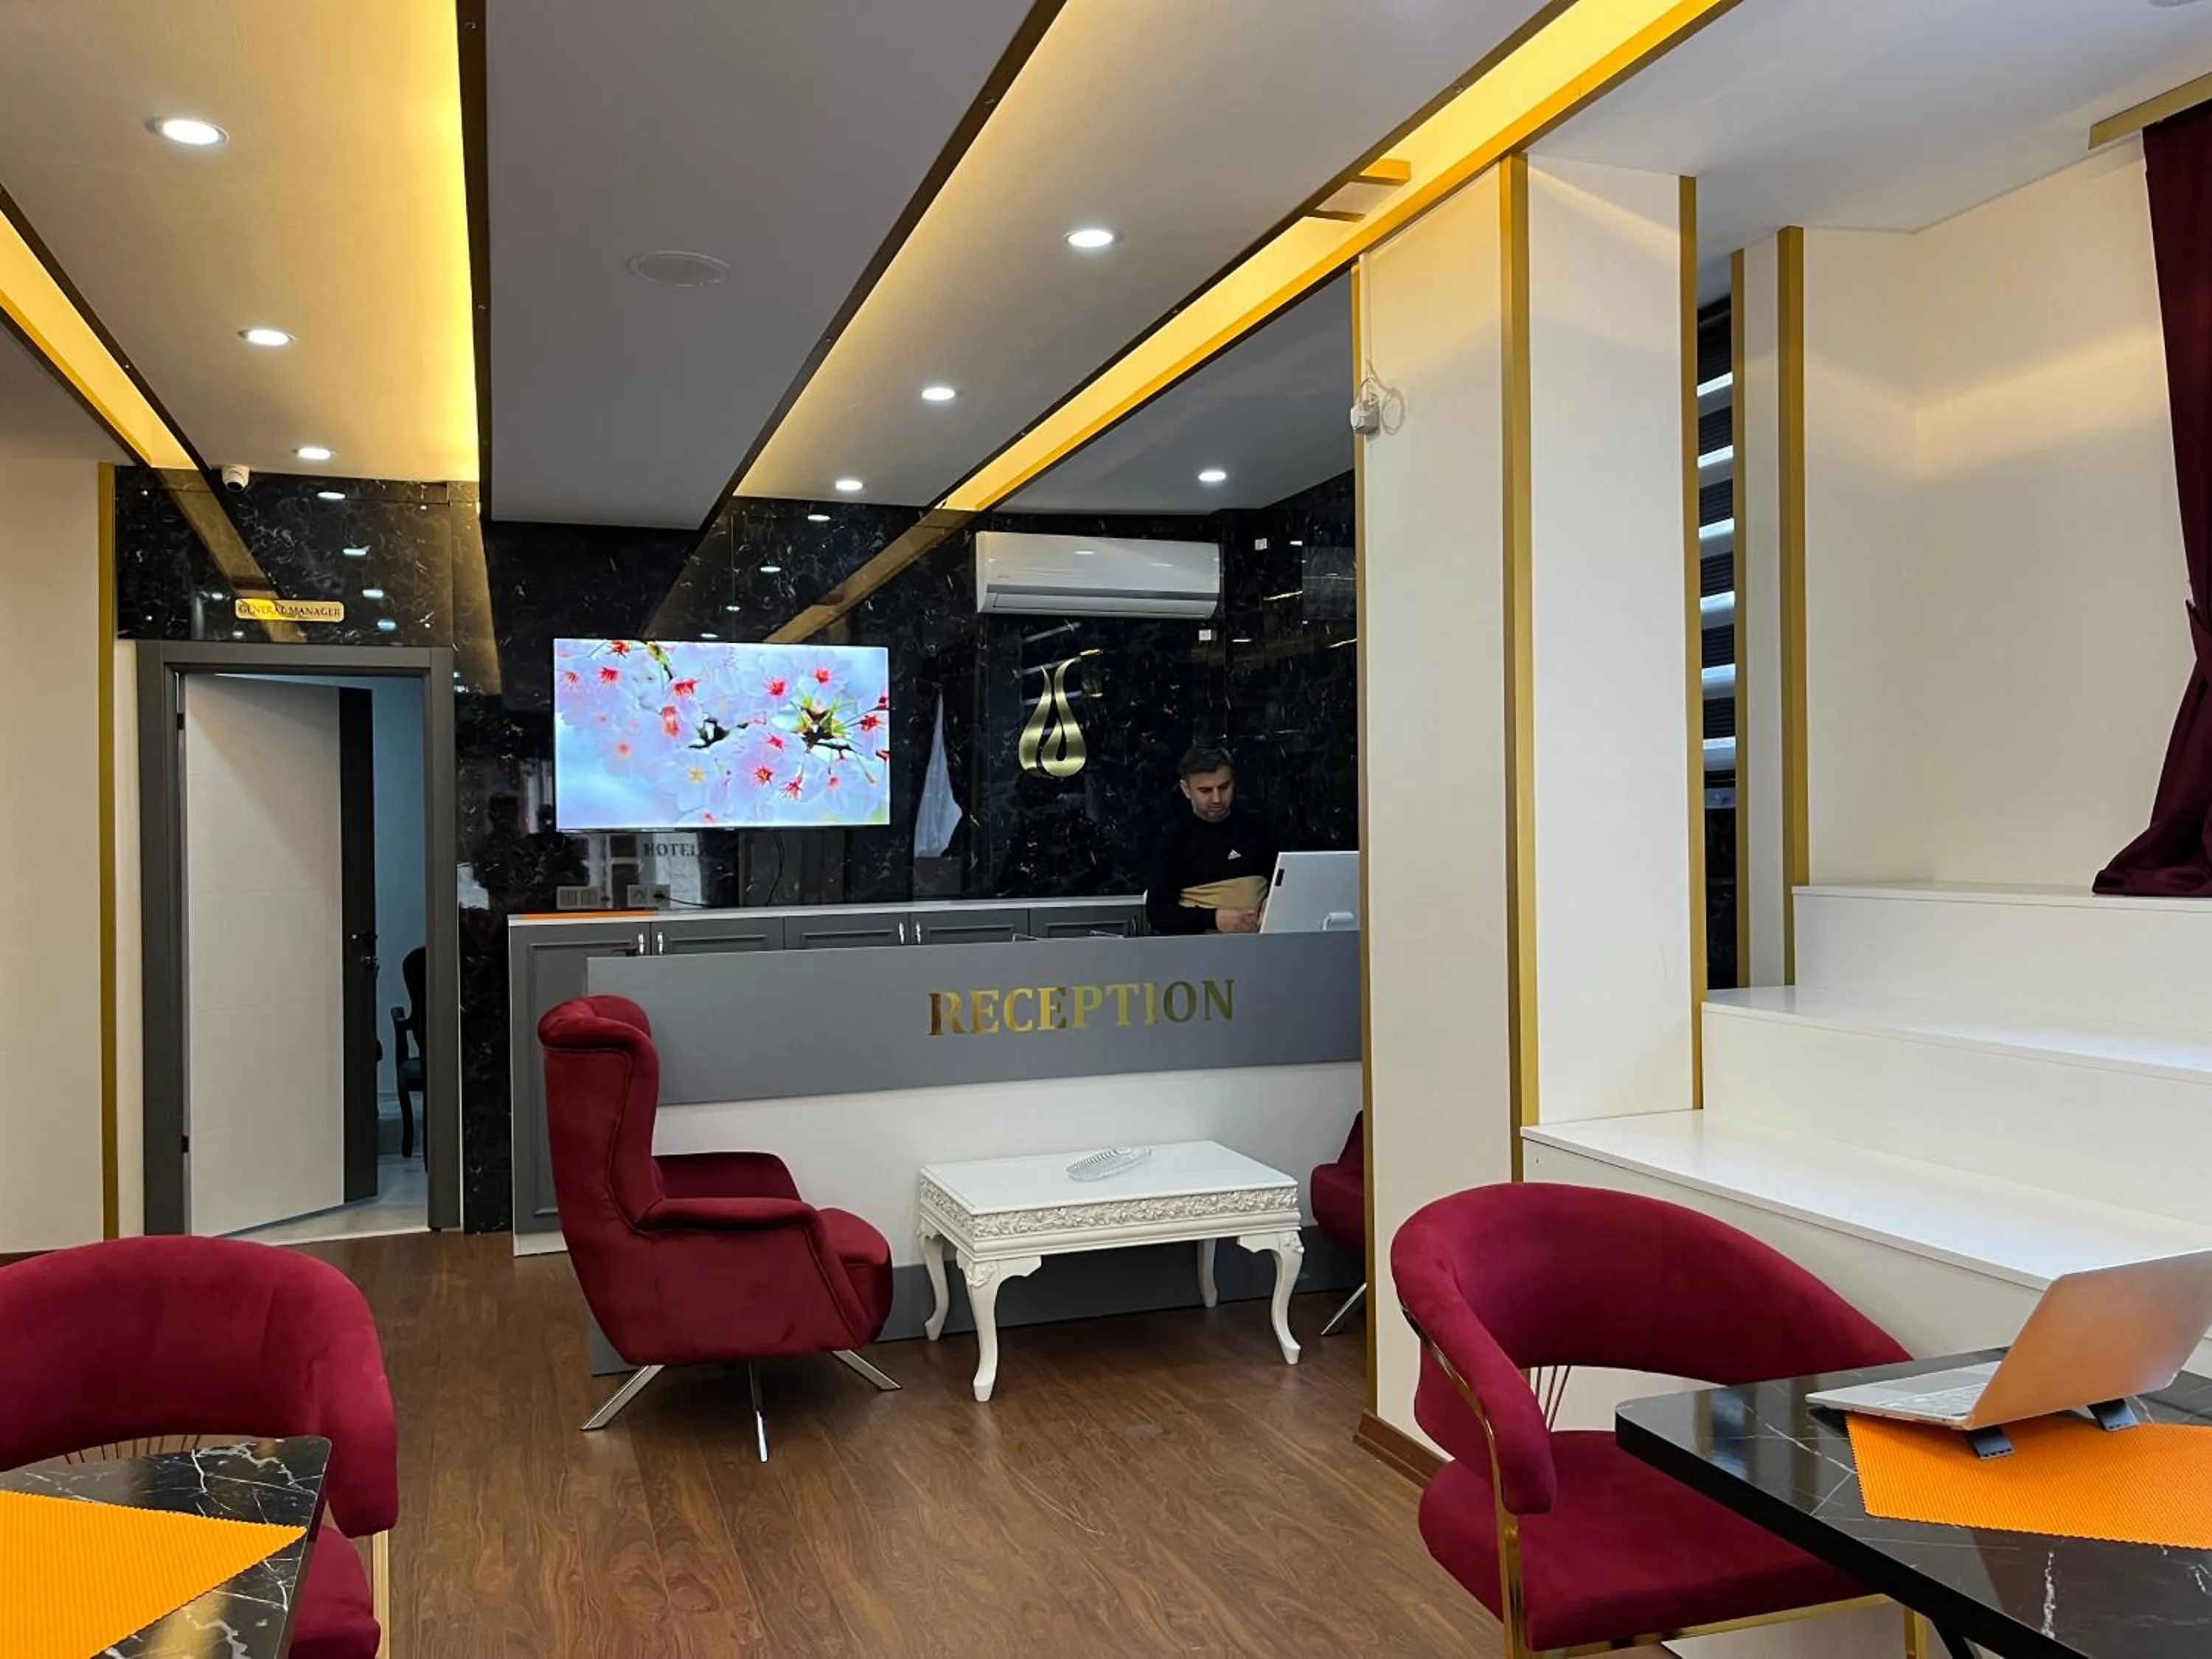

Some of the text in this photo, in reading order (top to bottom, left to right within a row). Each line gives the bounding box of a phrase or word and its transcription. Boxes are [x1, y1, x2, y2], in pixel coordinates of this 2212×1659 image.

[238, 604, 341, 616] GENERAL MANAGER
[928, 978, 1235, 1036] RECEPTION
